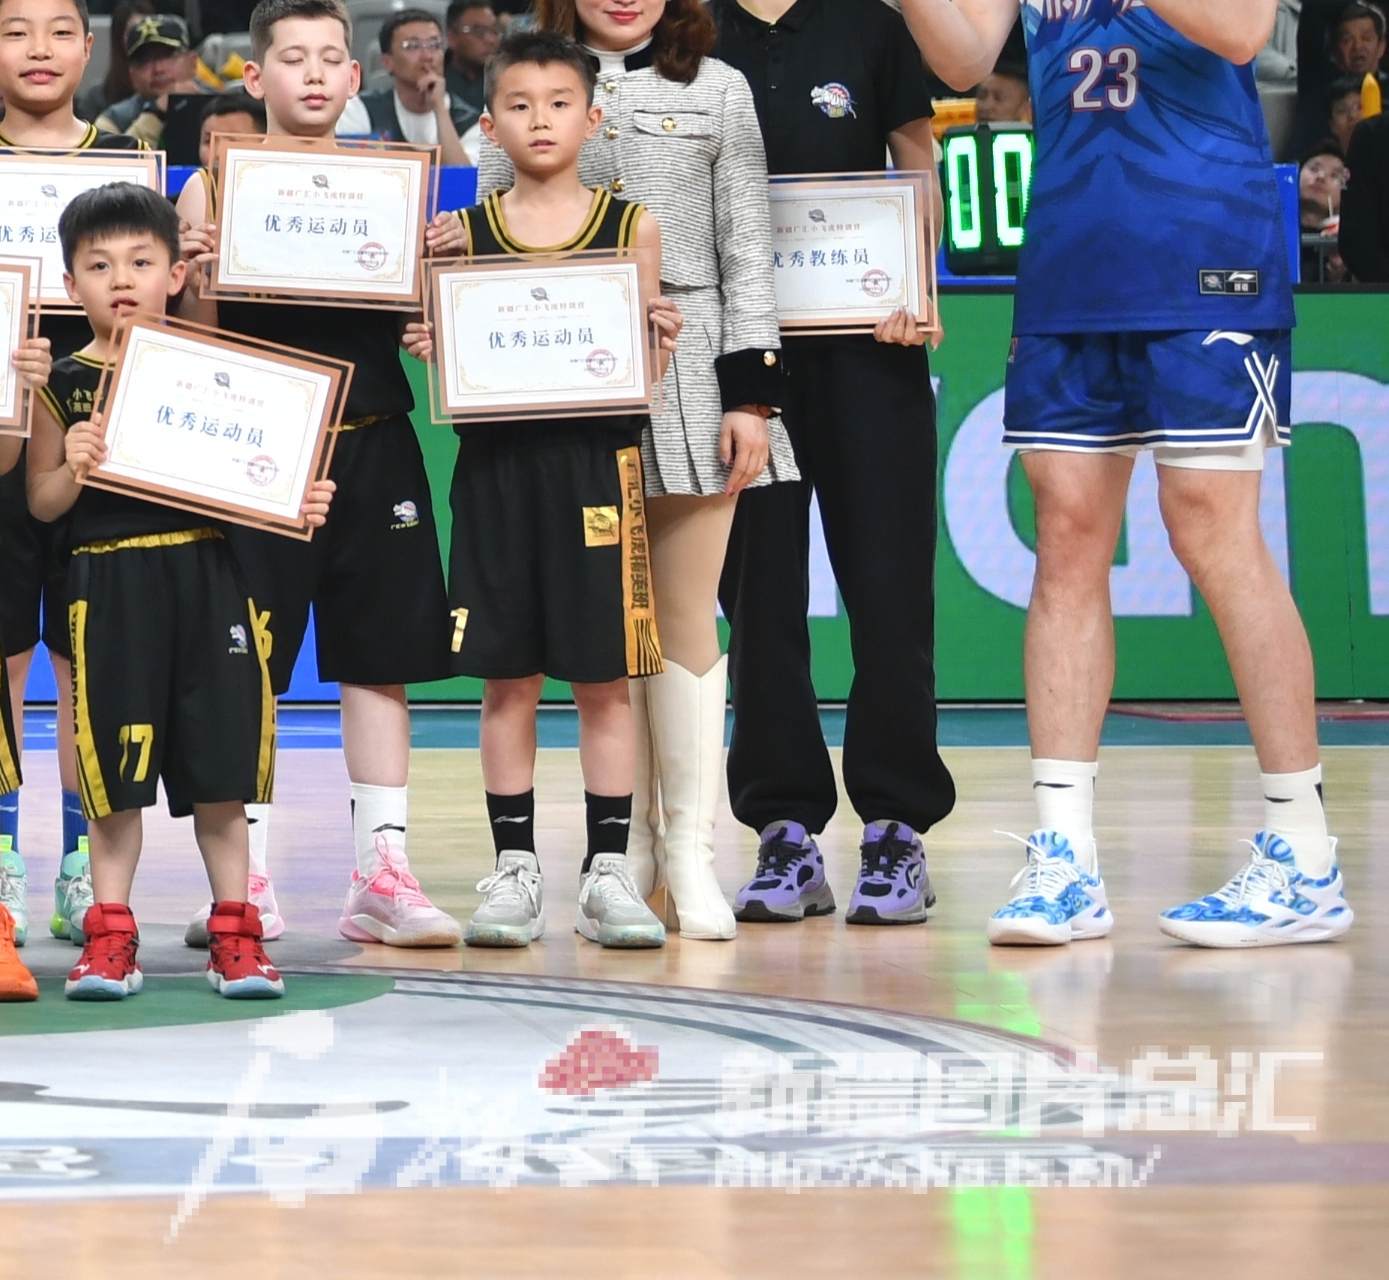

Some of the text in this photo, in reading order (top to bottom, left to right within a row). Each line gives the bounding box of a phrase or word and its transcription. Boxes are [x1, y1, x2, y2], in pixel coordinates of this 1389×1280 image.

[1069, 46, 1140, 112] 23
[264, 214, 369, 237] 优秀运动员
[488, 327, 595, 350] 优秀运动员
[156, 404, 265, 448] 优秀运动员
